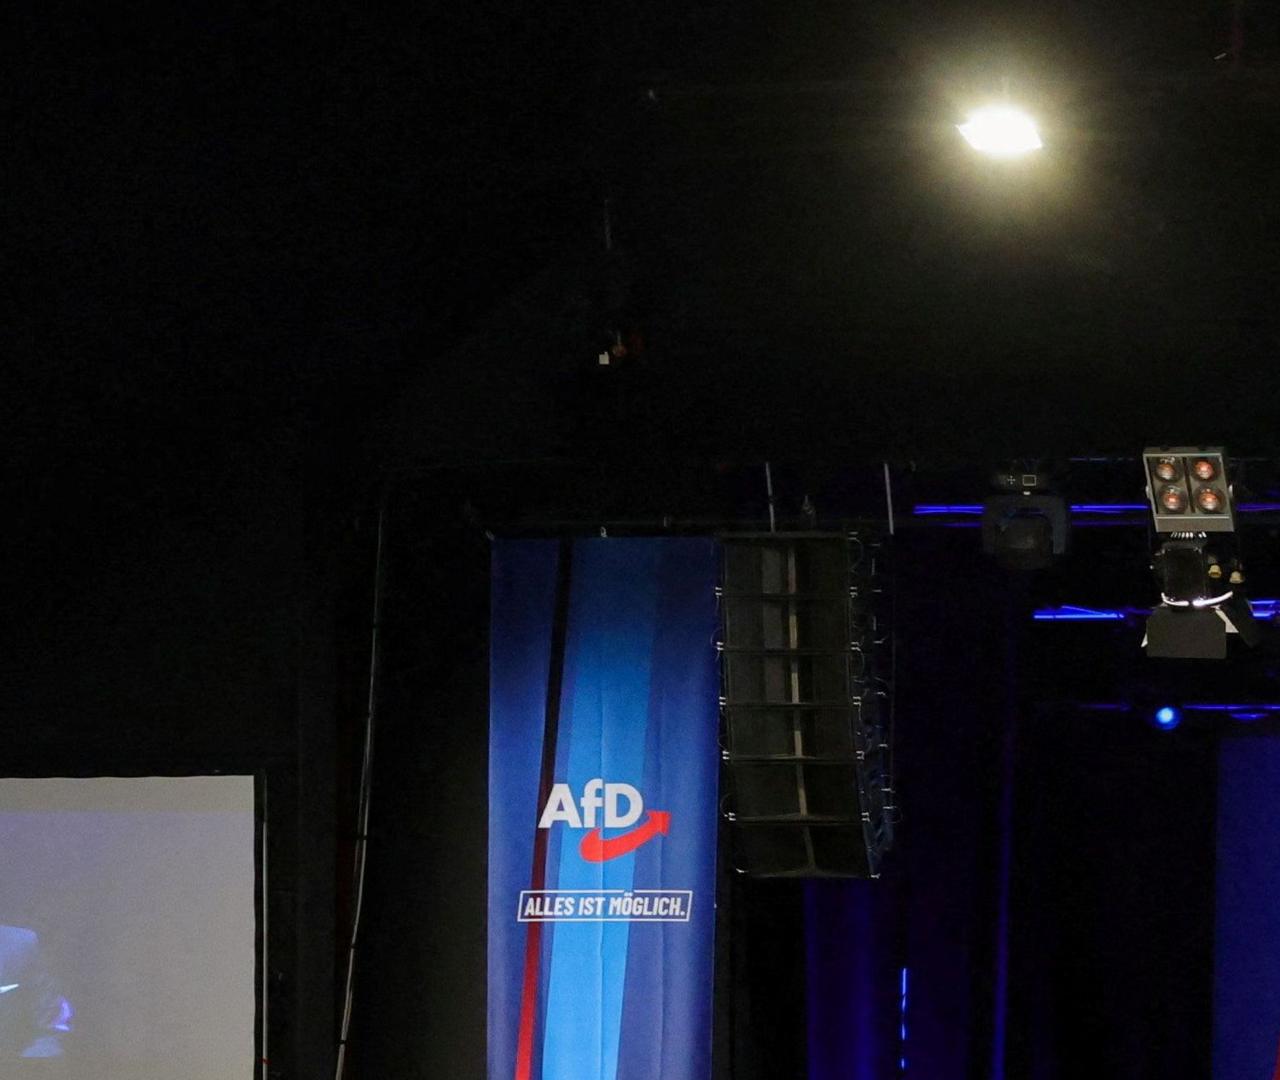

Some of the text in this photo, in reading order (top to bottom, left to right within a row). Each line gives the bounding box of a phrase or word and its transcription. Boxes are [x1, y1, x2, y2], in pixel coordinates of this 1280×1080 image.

[538, 778, 643, 828] AfD
[524, 892, 686, 916] ALLES IST MÖGLICH.
